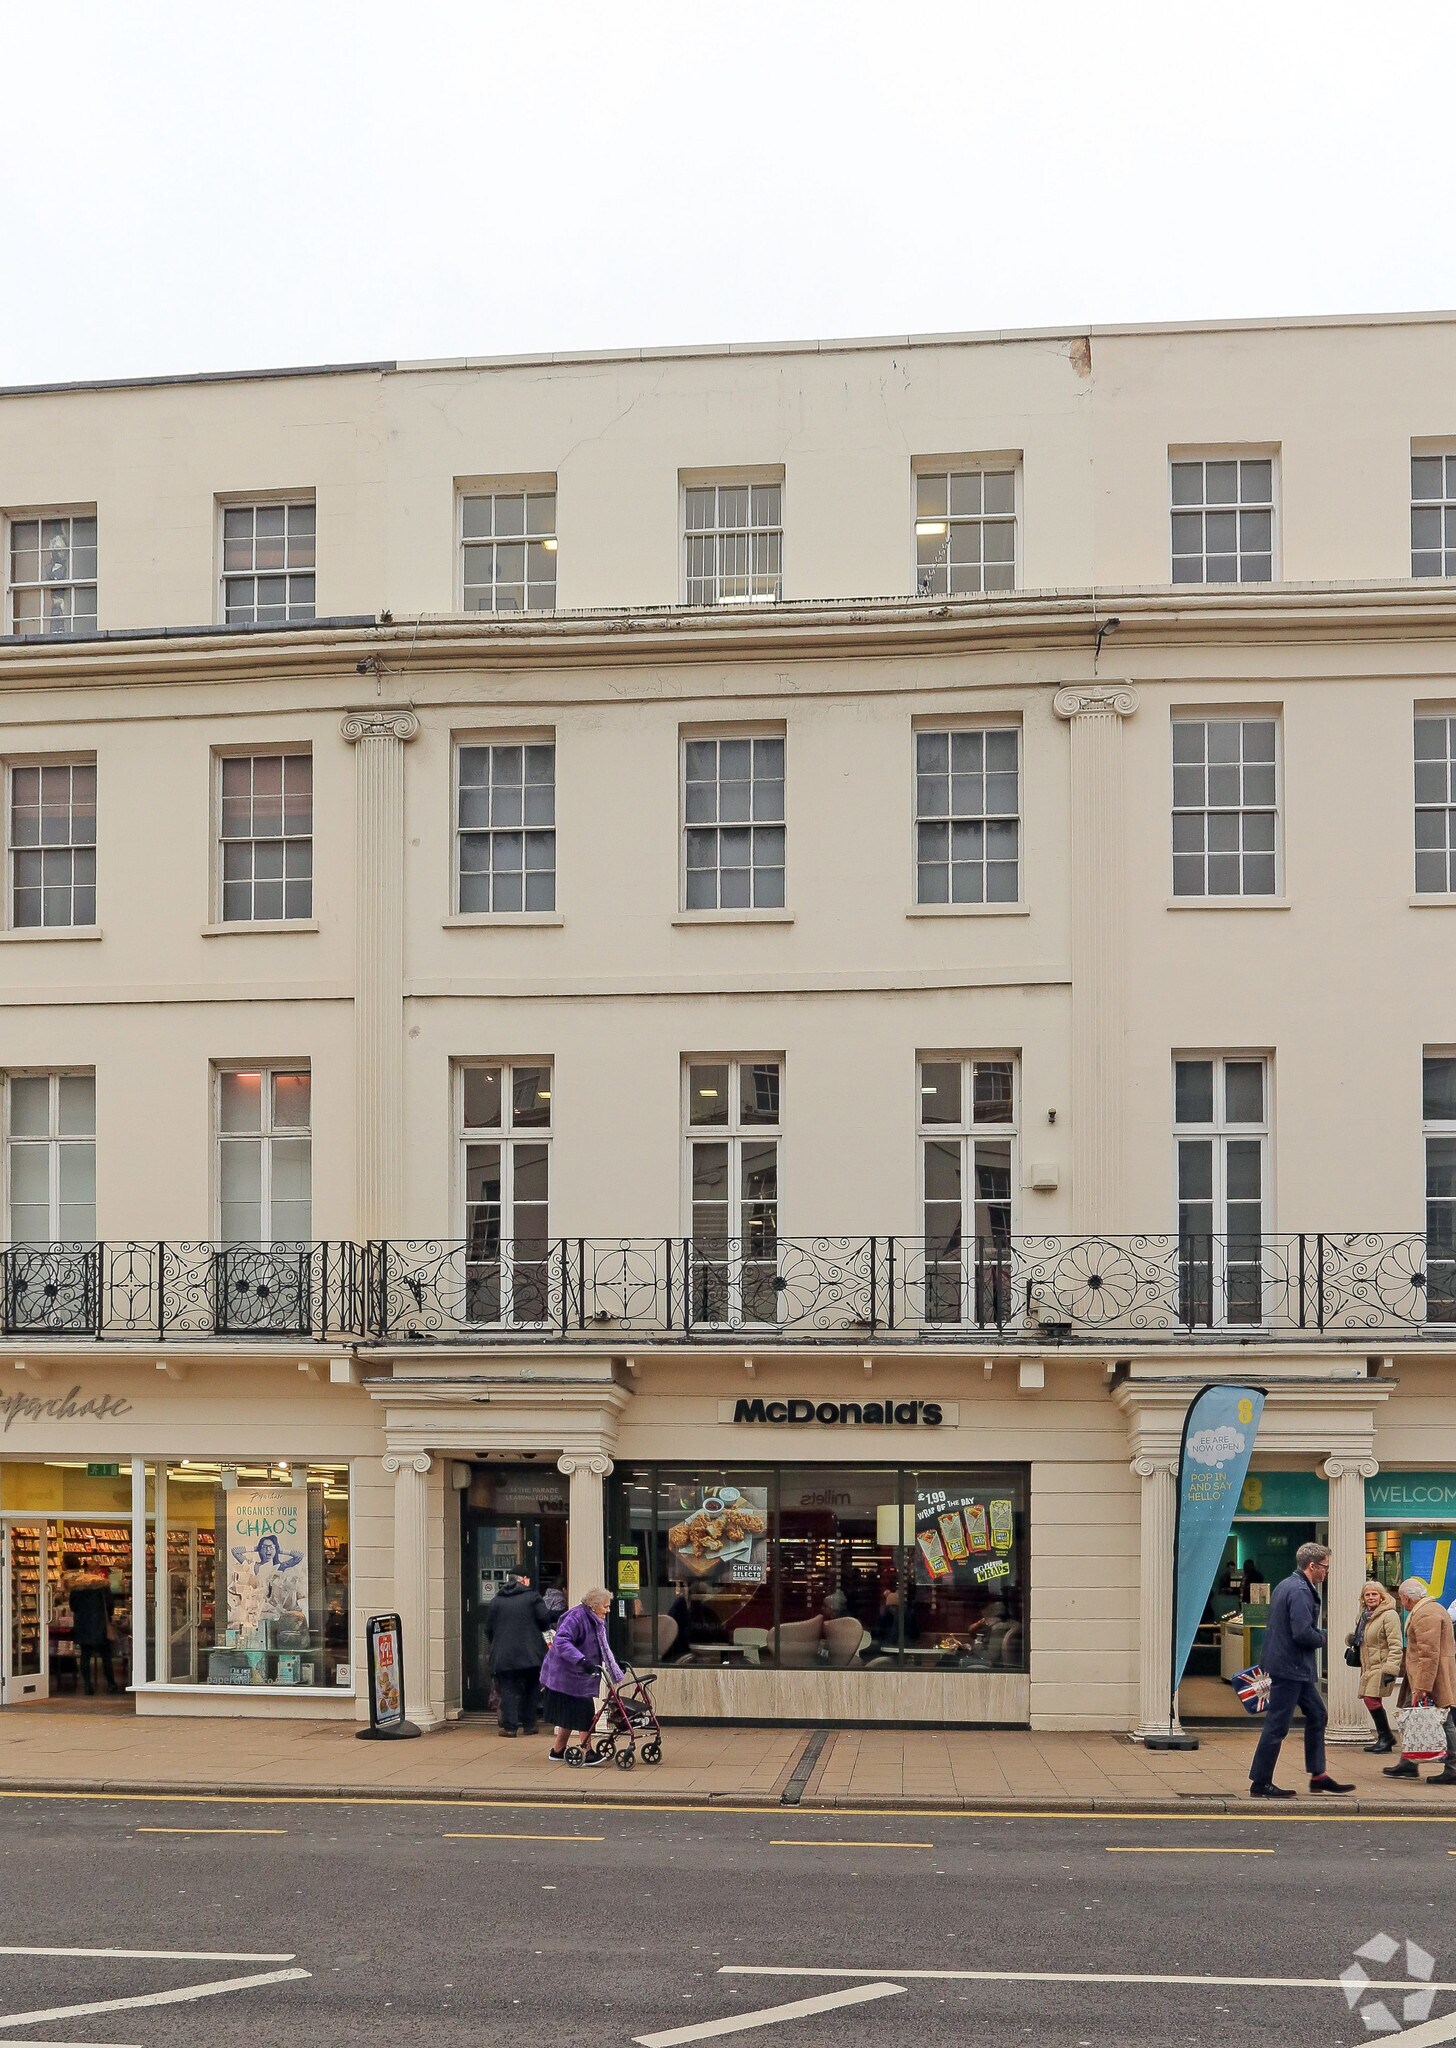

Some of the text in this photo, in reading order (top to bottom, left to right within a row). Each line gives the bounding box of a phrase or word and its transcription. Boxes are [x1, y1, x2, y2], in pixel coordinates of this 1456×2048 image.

[0, 1385, 133, 1433] aperchase
[733, 1398, 944, 1425] McDonald's
[1200, 1435, 1230, 1445] EE ARE
[1192, 1443, 1240, 1452] NOW OPEN
[1190, 1472, 1227, 1482] POP IN
[1189, 1481, 1233, 1492] AND SAY
[917, 1490, 946, 1505] £1.99
[1187, 1491, 1221, 1501] HELLO
[236, 1506, 298, 1516] ORGANISE YOUR
[917, 1496, 975, 1520] WRAP OF THE DAY
[236, 1517, 298, 1537] CHAOS
